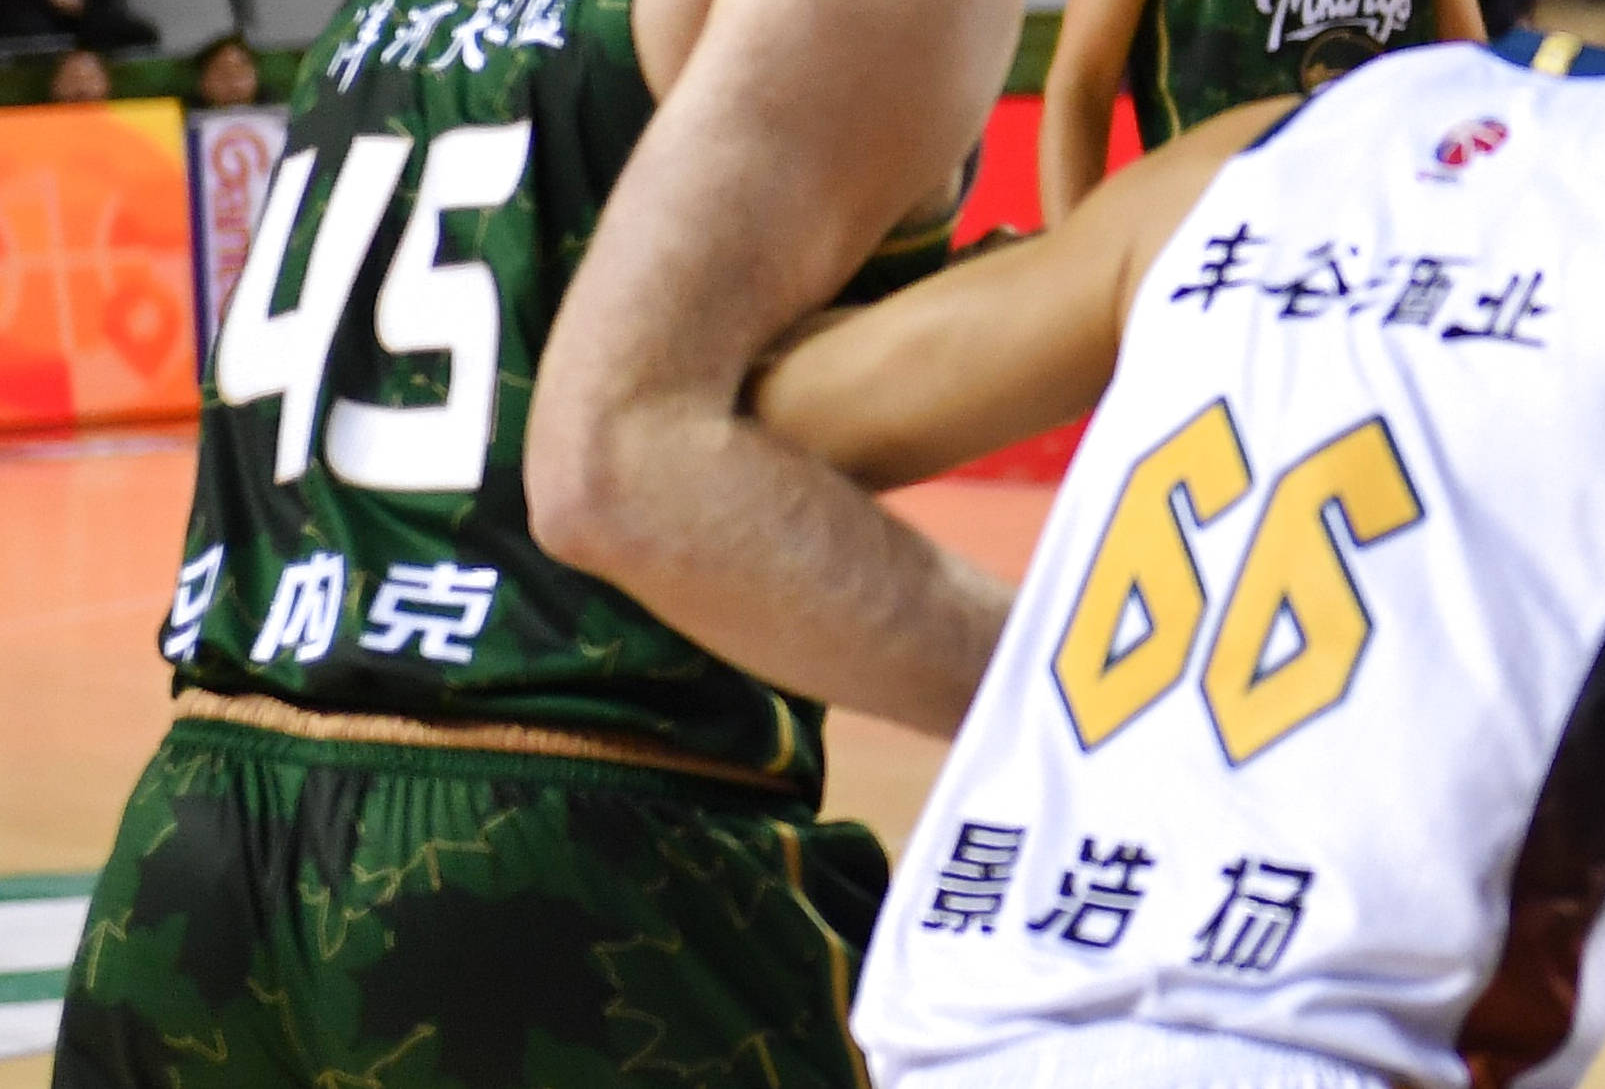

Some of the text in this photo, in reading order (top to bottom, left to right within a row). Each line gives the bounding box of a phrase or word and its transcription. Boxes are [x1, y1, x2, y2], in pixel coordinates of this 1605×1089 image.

[214, 117, 533, 492] 45
[1170, 222, 1548, 347] 丰谷酒业
[1050, 395, 1425, 768] 66
